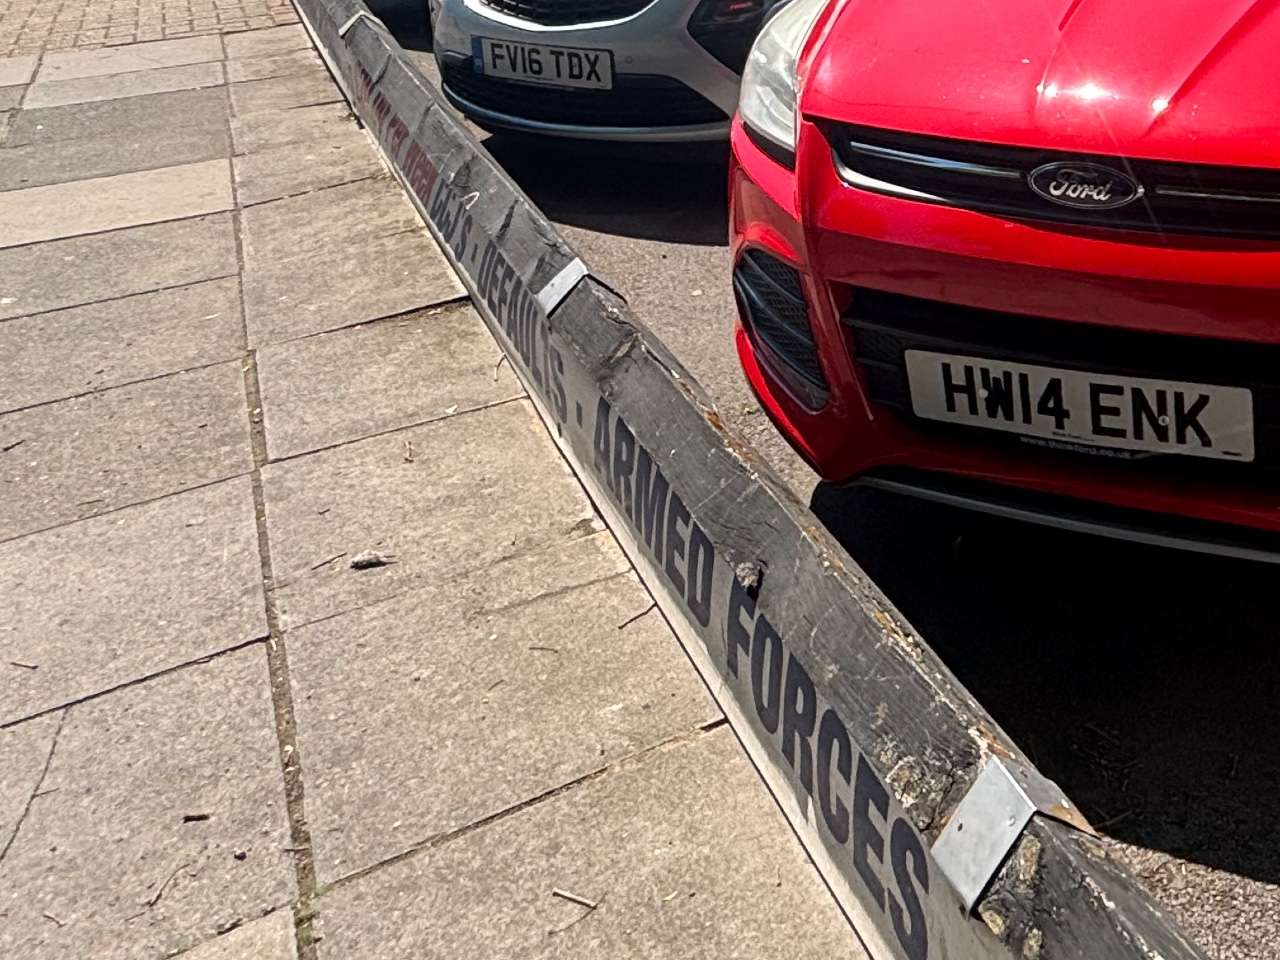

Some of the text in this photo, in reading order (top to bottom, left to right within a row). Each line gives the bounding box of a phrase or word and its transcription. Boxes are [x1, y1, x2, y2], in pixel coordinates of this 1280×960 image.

[490, 43, 602, 81] FV16 TDX
[1049, 168, 1115, 201] Ford
[941, 363, 1213, 448] HW14 ENK
[594, 395, 715, 629] ARMED
[726, 575, 930, 960] FORCES
